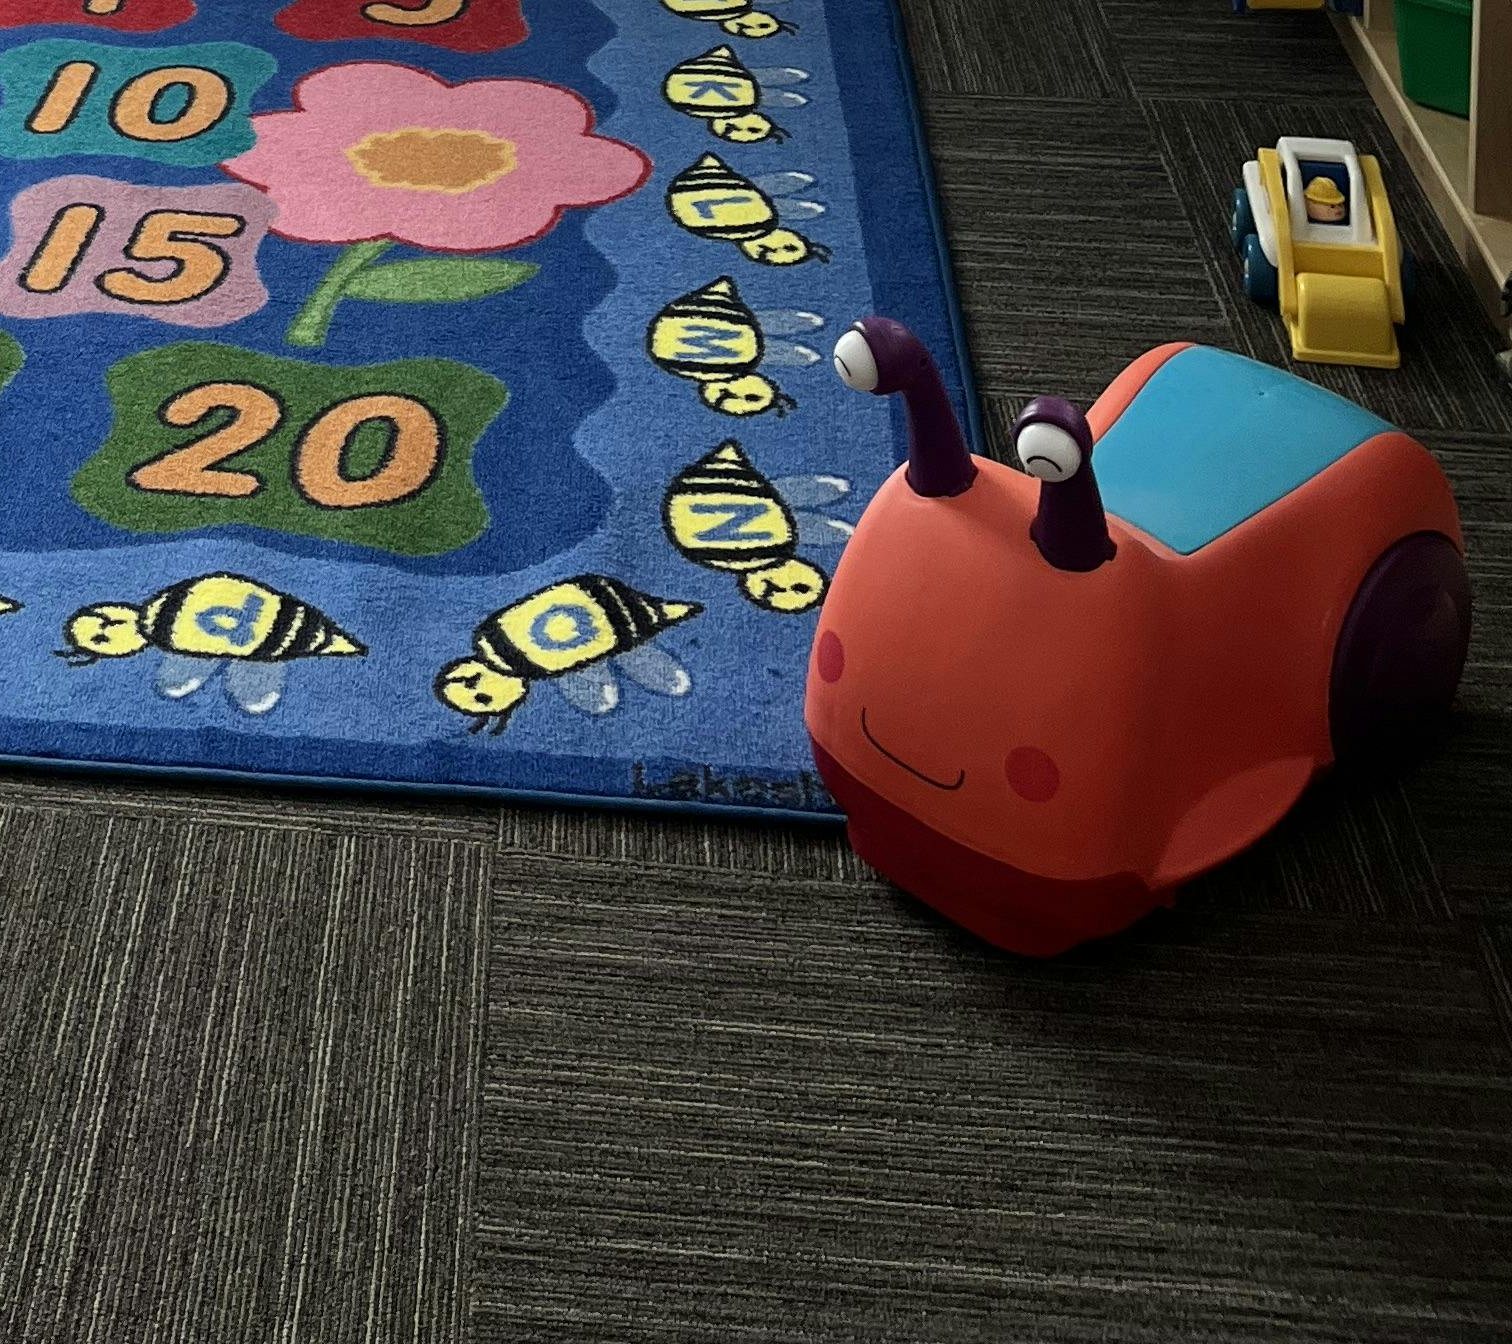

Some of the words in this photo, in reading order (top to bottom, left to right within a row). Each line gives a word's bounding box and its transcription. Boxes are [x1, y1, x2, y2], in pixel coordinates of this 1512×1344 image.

[23, 59, 236, 143] 10
[683, 80, 742, 102] K
[691, 195, 752, 219] L
[17, 203, 247, 305] 15
[126, 381, 447, 510] 20
[530, 602, 599, 650] O
